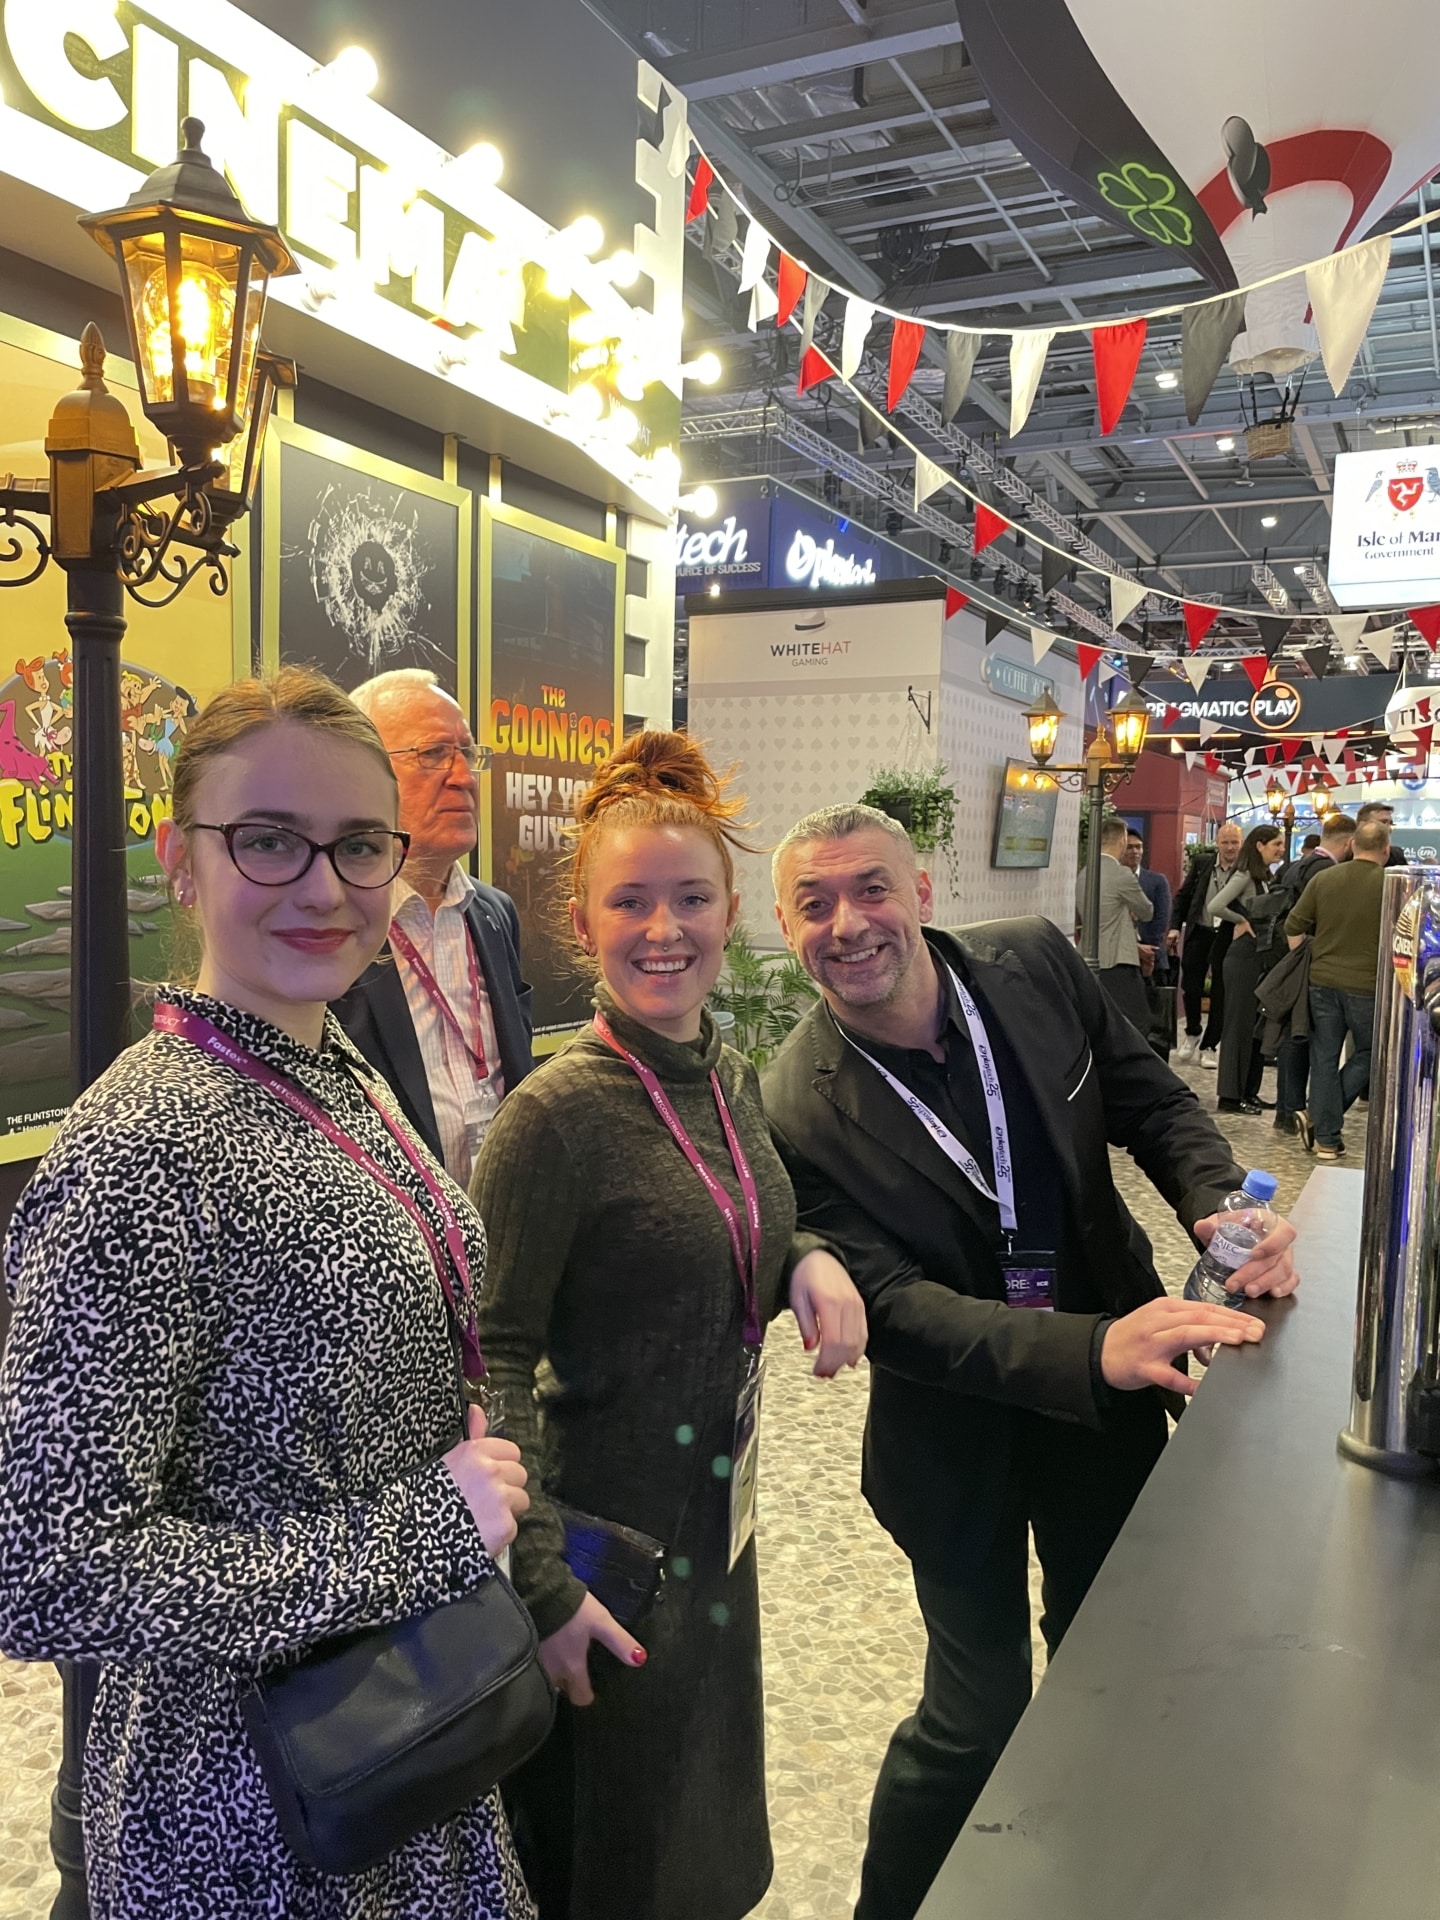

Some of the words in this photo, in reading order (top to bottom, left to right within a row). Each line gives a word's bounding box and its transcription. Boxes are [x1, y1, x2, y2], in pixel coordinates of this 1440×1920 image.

[1357, 531, 1386, 547] Isle
[1389, 532, 1403, 545] of
[1364, 547, 1434, 560] Government
[704, 564, 717, 576] OF
[717, 561, 761, 575] SUCCESS
[770, 641, 852, 657] WHITEHAT
[791, 657, 828, 667] GAMING
[1002, 665, 1028, 693] COFFEE
[1254, 699, 1298, 717] PLAY
[505, 771, 552, 811] HEY
[206, 1036, 243, 1064] Fastex
[269, 1079, 334, 1134] BETCONSTRUCT
[965, 1003, 977, 1017] 25
[986, 1083, 999, 1097] 25
[997, 1164, 1011, 1179] 25
[6, 1114, 23, 1126] THE
[653, 1090, 685, 1141] BETCONSTRUCT
[696, 1162, 714, 1188] Fastex
[437, 1197, 455, 1230] Fastex
